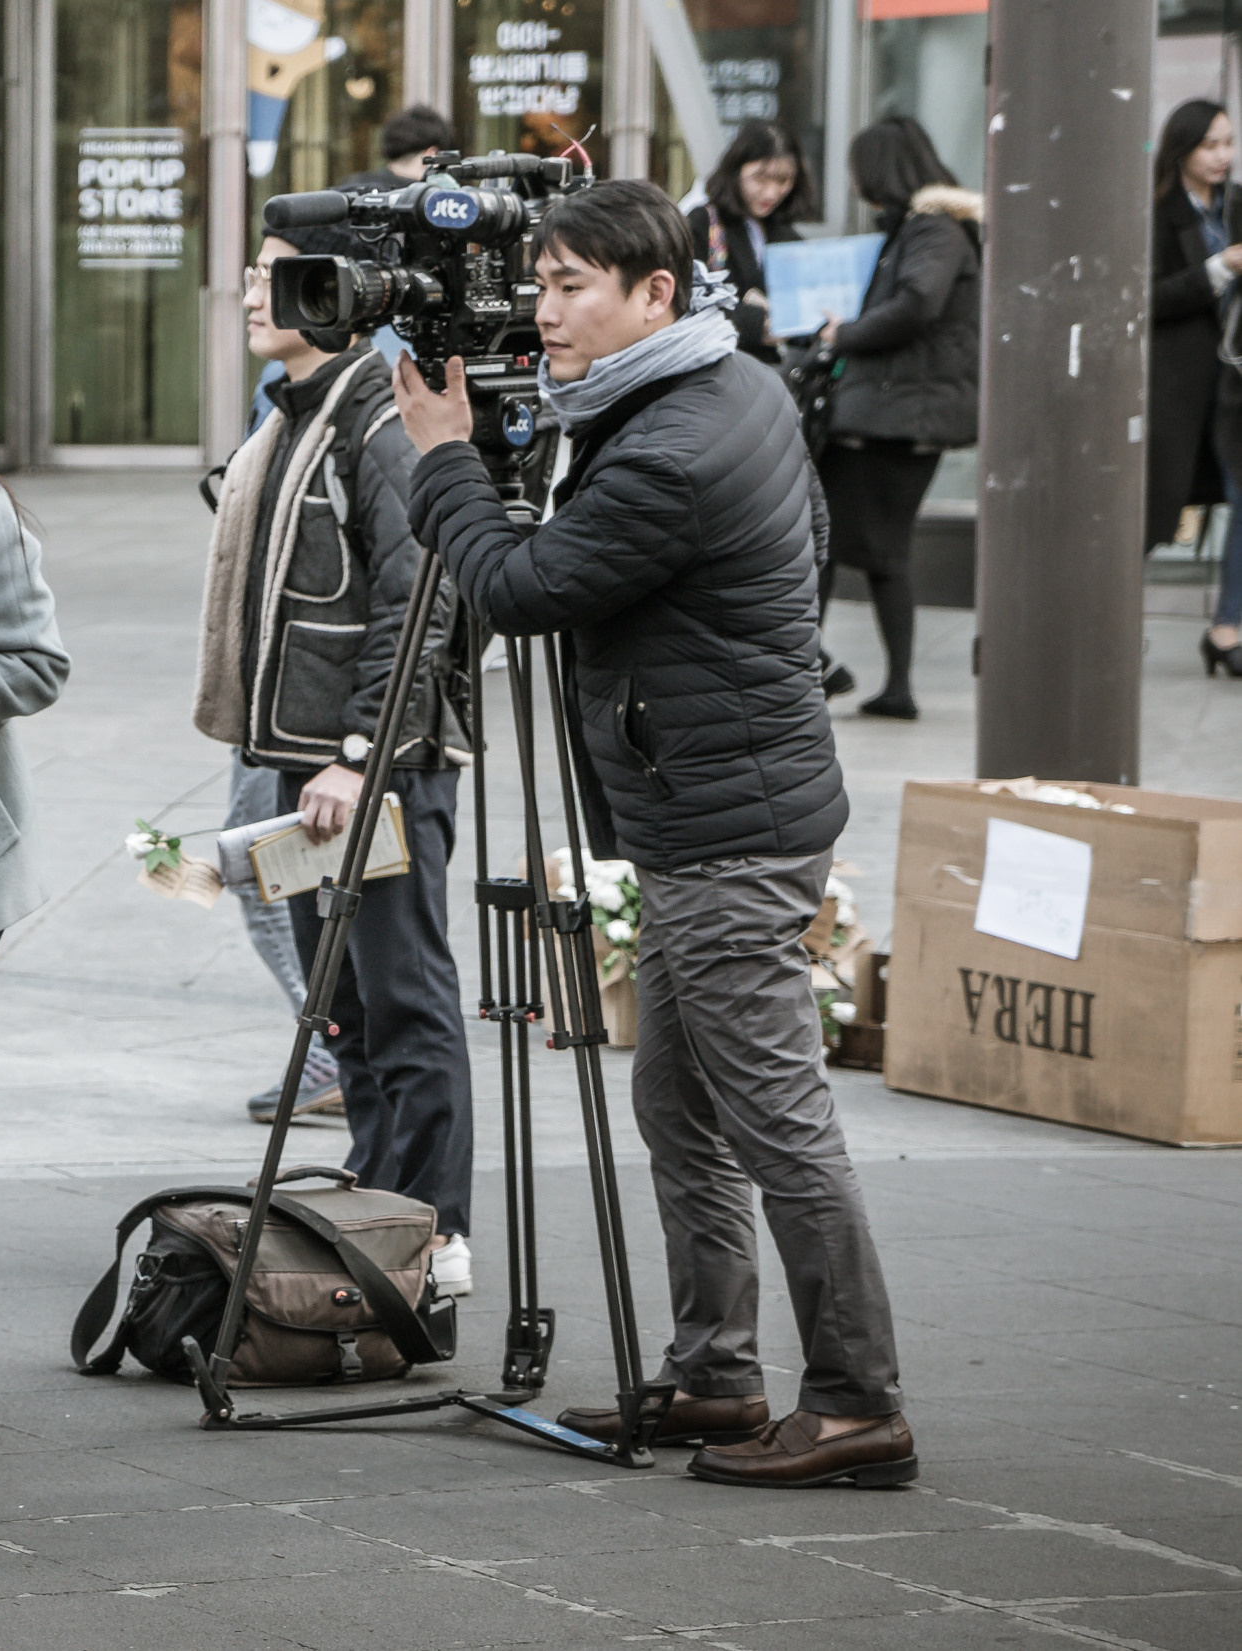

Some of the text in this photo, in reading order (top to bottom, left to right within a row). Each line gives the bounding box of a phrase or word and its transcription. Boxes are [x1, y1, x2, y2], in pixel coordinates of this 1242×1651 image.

[78, 159, 185, 188] POPUP
[78, 188, 183, 219] STORE
[958, 966, 1097, 1061] HERA
